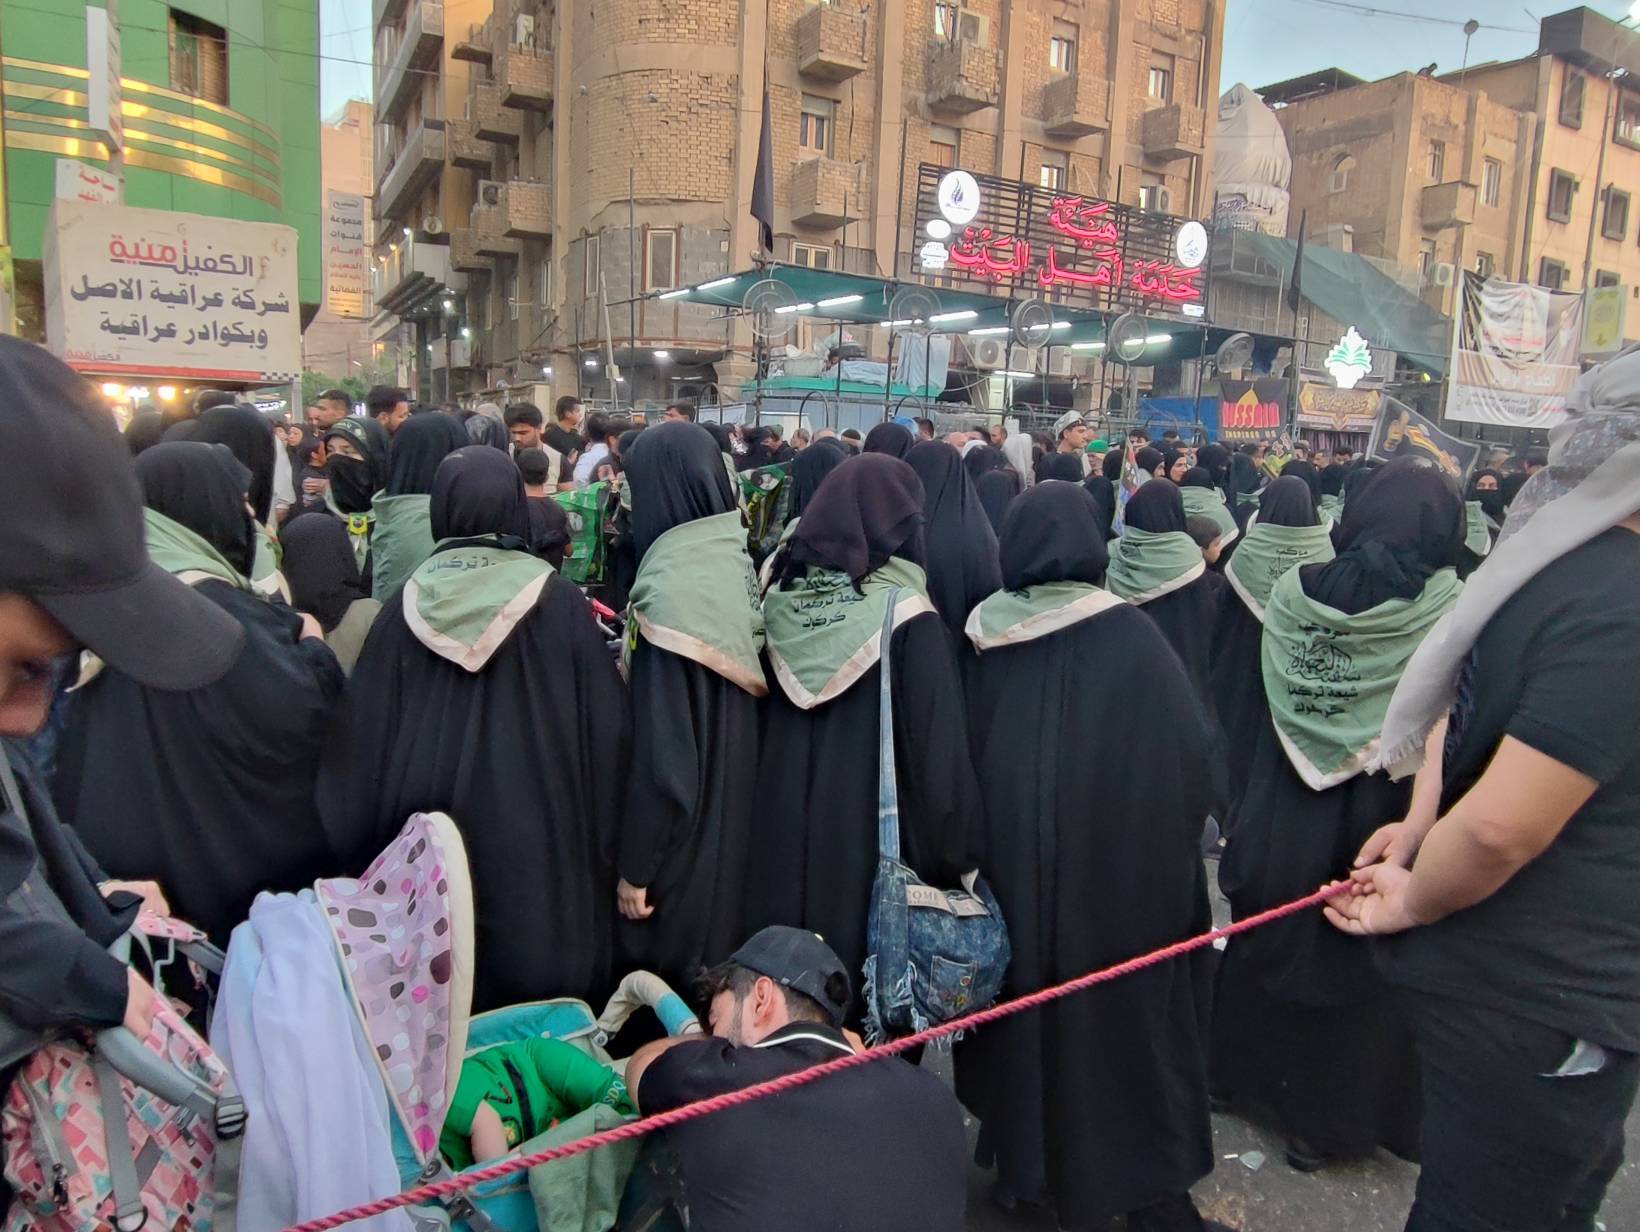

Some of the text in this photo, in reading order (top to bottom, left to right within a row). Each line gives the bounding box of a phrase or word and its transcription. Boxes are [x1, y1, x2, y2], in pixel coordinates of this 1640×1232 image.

[70, 273, 290, 317] شركة عراقية الاصل
[99, 310, 269, 350] وبكوادر عراقية
